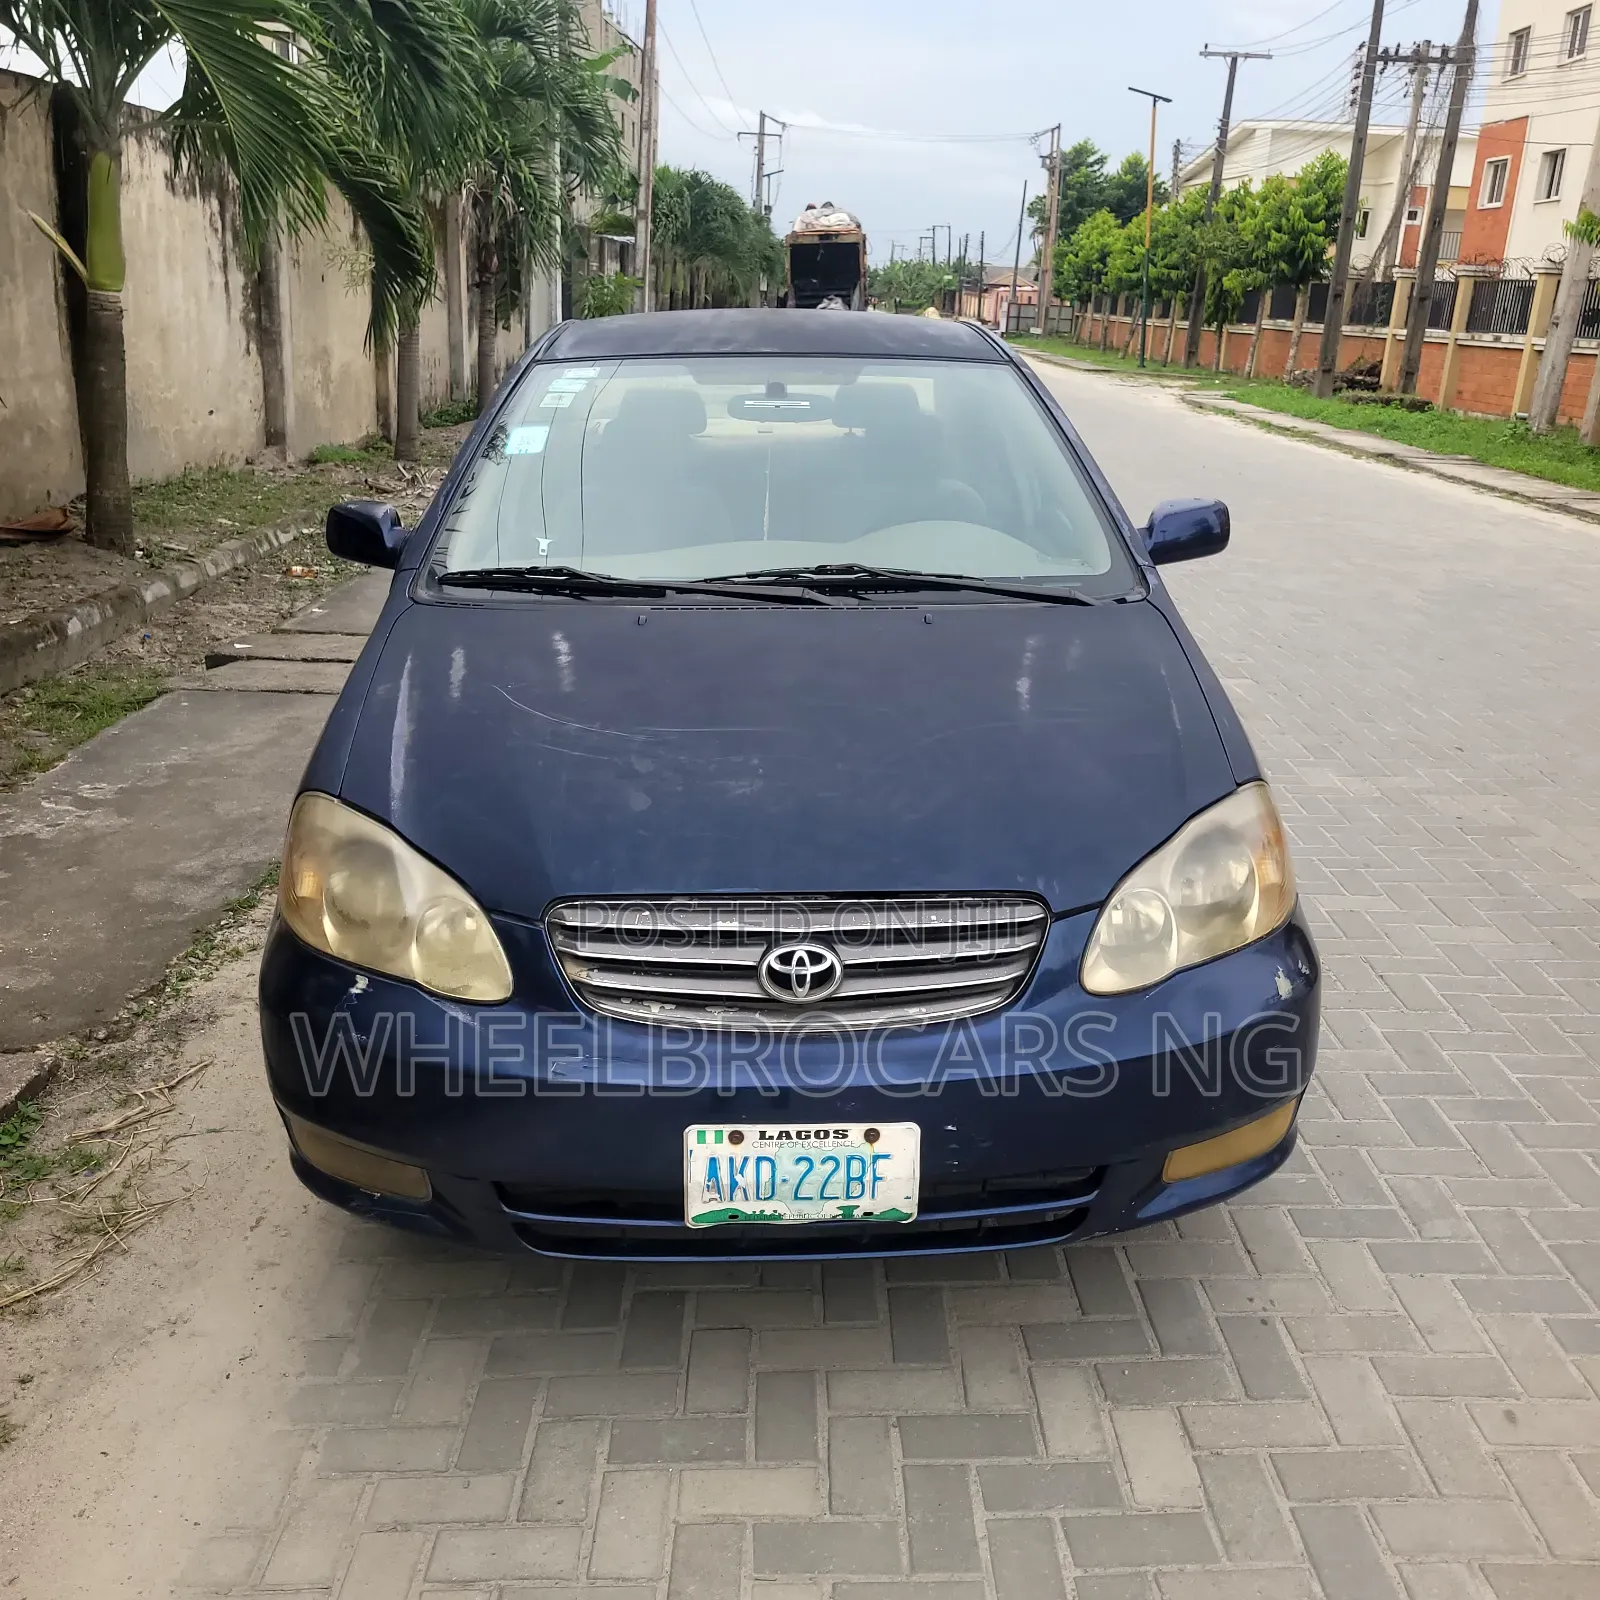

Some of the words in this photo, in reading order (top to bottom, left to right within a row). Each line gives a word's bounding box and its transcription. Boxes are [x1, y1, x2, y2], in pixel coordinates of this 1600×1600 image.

[758, 1129, 849, 1141] LAGOS
[751, 1140, 785, 1149] CENTRE
[786, 1140, 800, 1148] OF
[801, 1140, 855, 1149] EXCELLENCE
